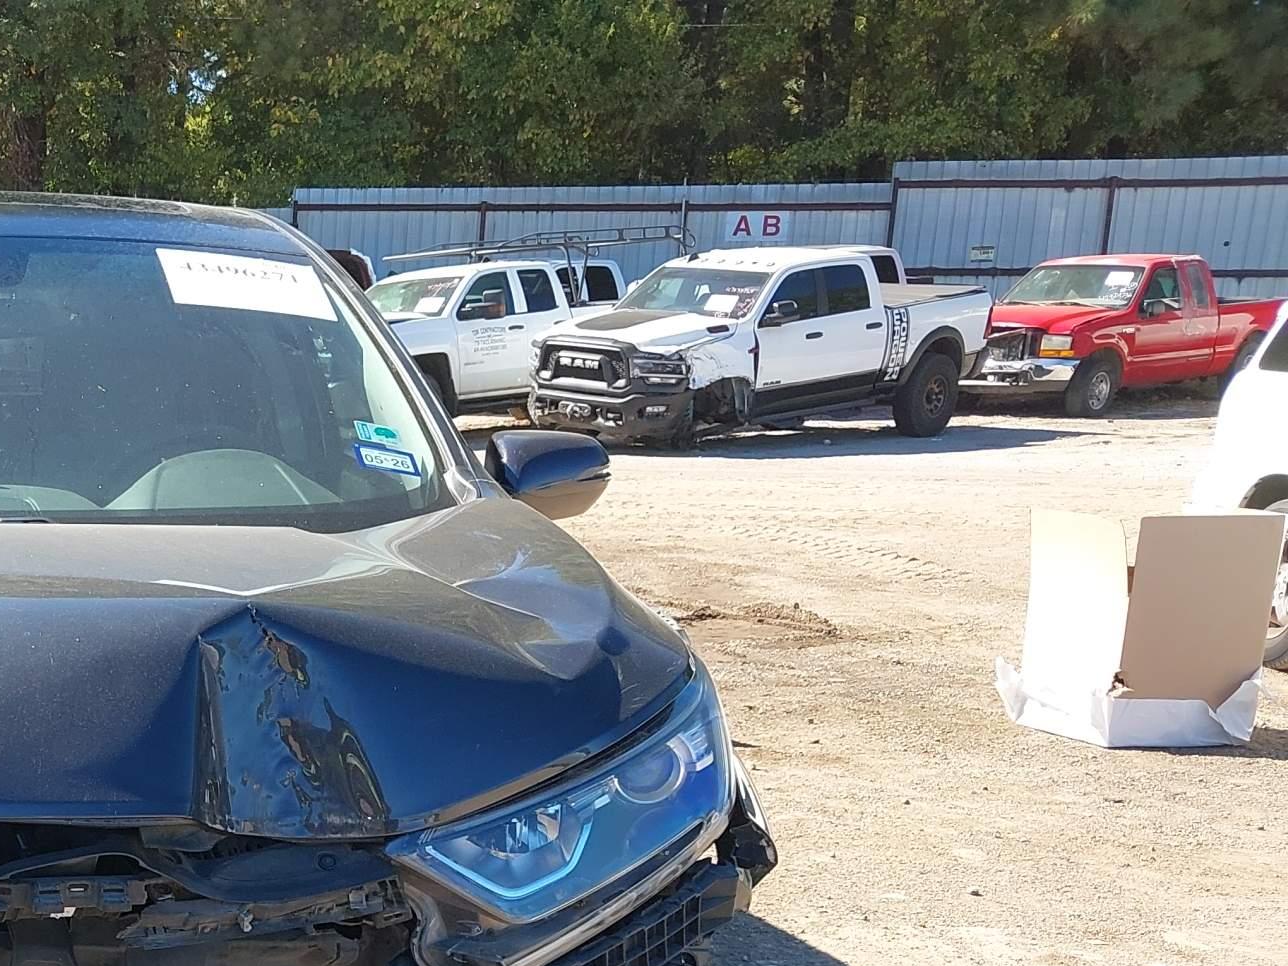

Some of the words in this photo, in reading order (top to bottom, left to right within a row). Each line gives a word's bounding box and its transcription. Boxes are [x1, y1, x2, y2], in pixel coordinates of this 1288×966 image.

[732, 215, 751, 236] A
[762, 215, 781, 236] B
[559, 357, 600, 370] RAM
[884, 309, 901, 381] WAGON
[892, 308, 908, 380] POWER
